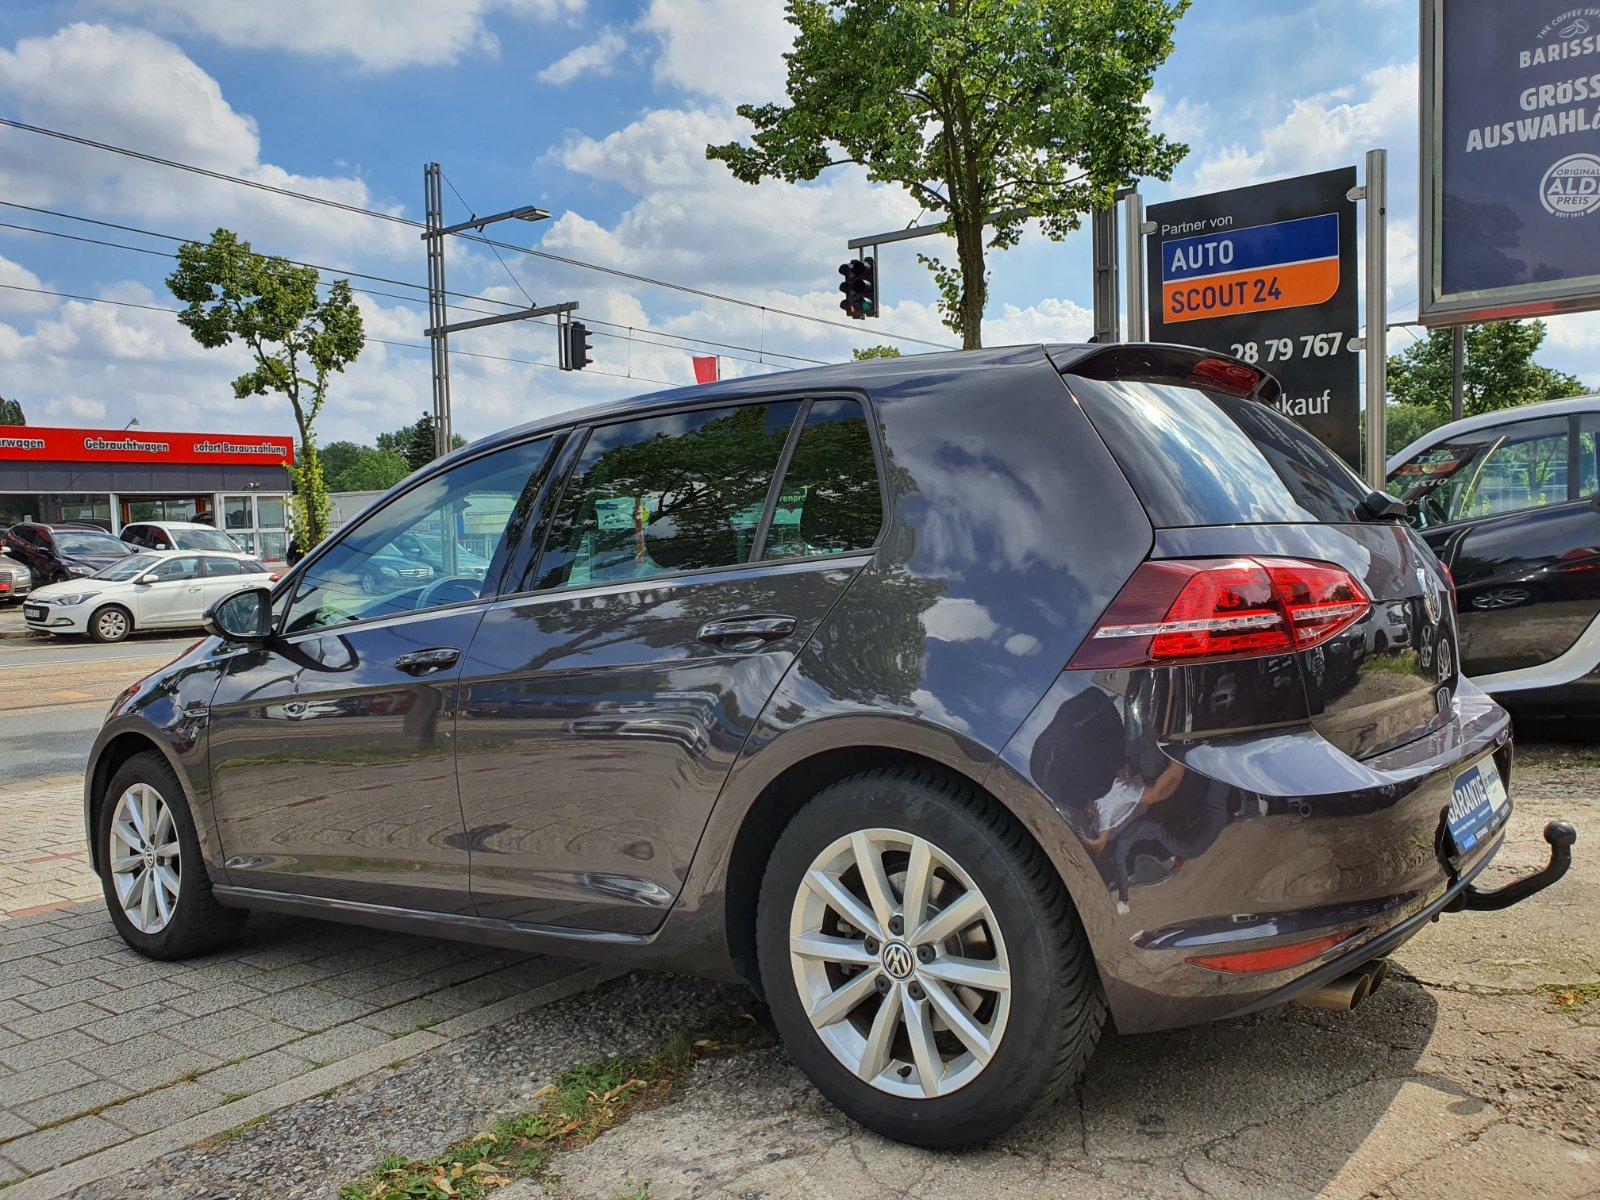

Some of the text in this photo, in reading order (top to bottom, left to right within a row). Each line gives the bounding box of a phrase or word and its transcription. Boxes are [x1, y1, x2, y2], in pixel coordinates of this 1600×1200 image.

[1536, 24, 1551, 40] THE
[1552, 9, 1582, 25] COFFEE
[1556, 196, 1590, 205] PREIS
[1161, 215, 1233, 236] Partner von
[1171, 240, 1234, 273] AUTO
[1171, 277, 1282, 314] SCOUT 24
[1230, 331, 1343, 364] 28 79 767
[1275, 389, 1331, 417] kauf
[84, 438, 169, 453] Gebrauchtwagen
[194, 441, 287, 456] sofort Barauszahlung
[1448, 775, 1488, 825] GARANTIE
